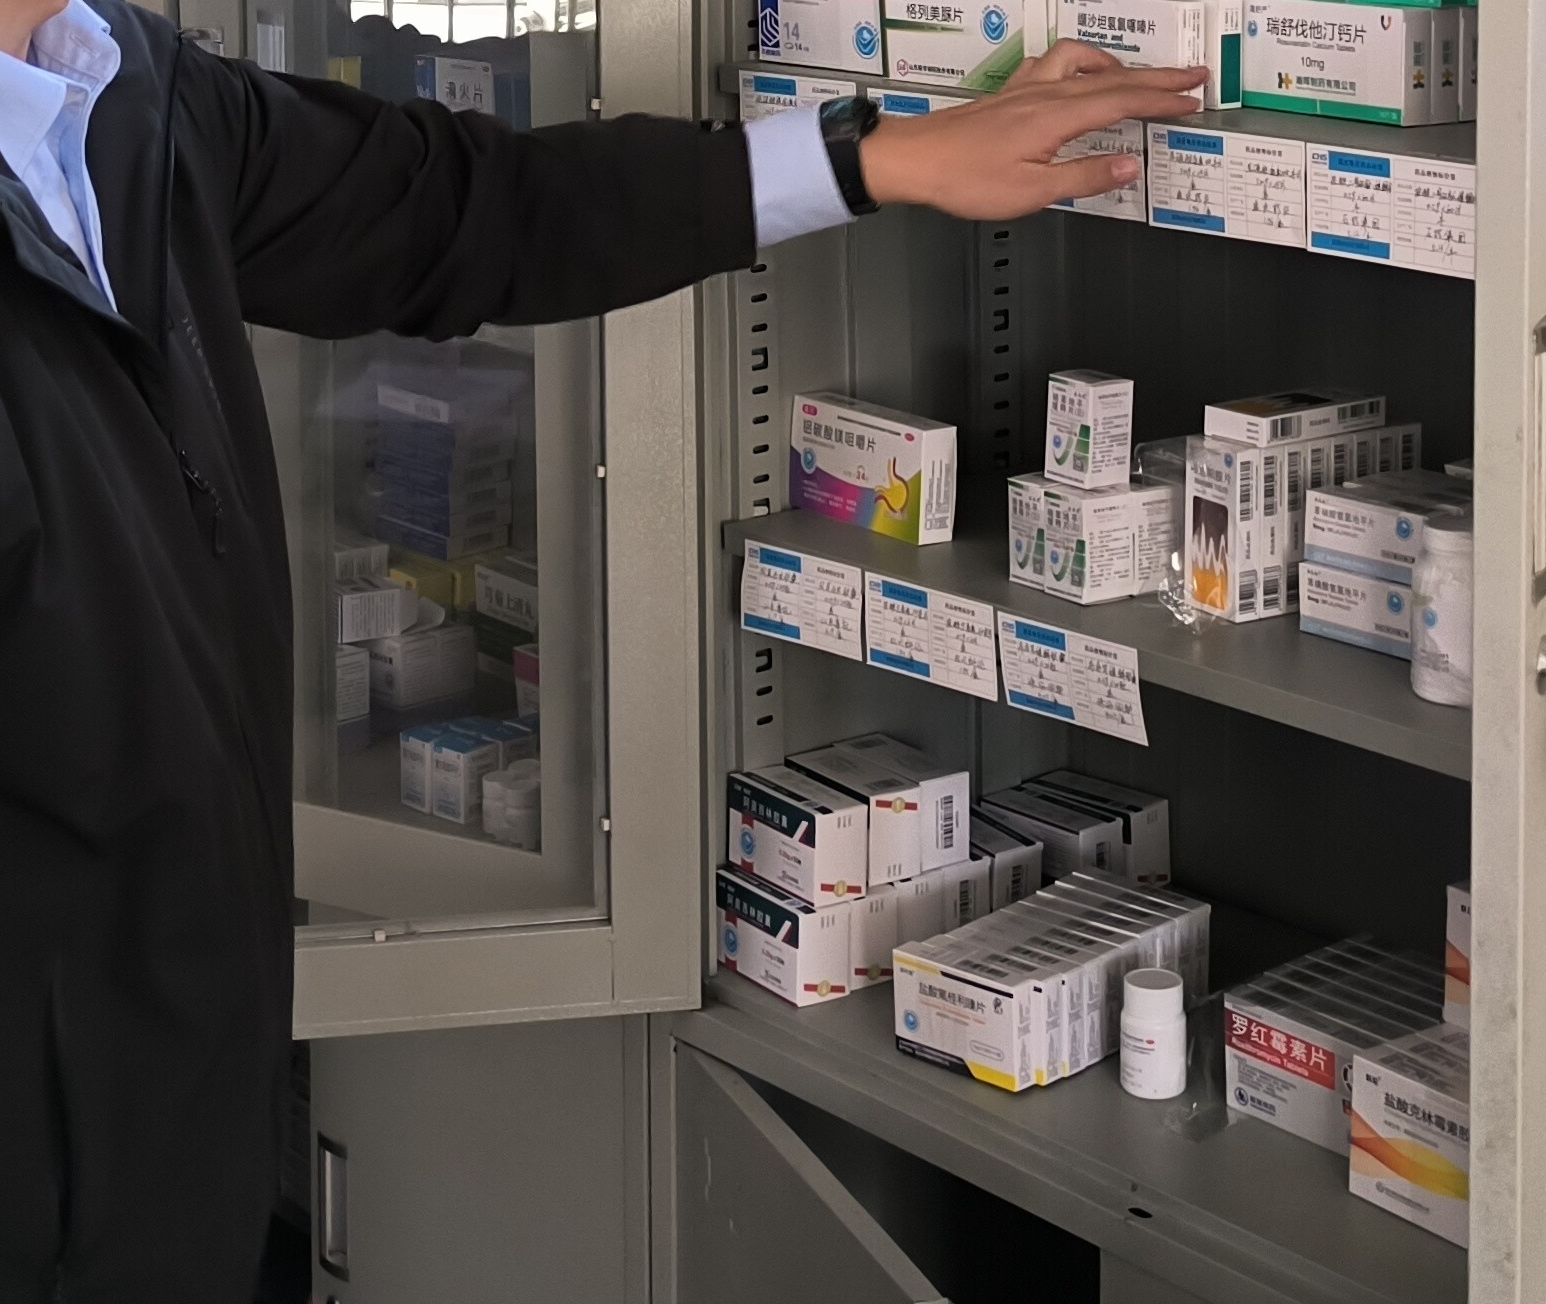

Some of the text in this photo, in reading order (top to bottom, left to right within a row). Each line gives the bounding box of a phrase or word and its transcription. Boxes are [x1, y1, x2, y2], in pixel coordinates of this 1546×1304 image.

[906, 2, 964, 24] 格列美脲片
[783, 22, 800, 42] 14
[1266, 17, 1367, 45] 瑞舒伐他汀钙片
[1301, 56, 1325, 72] 10mg
[1232, 1013, 1328, 1072] 罗红霉素片
